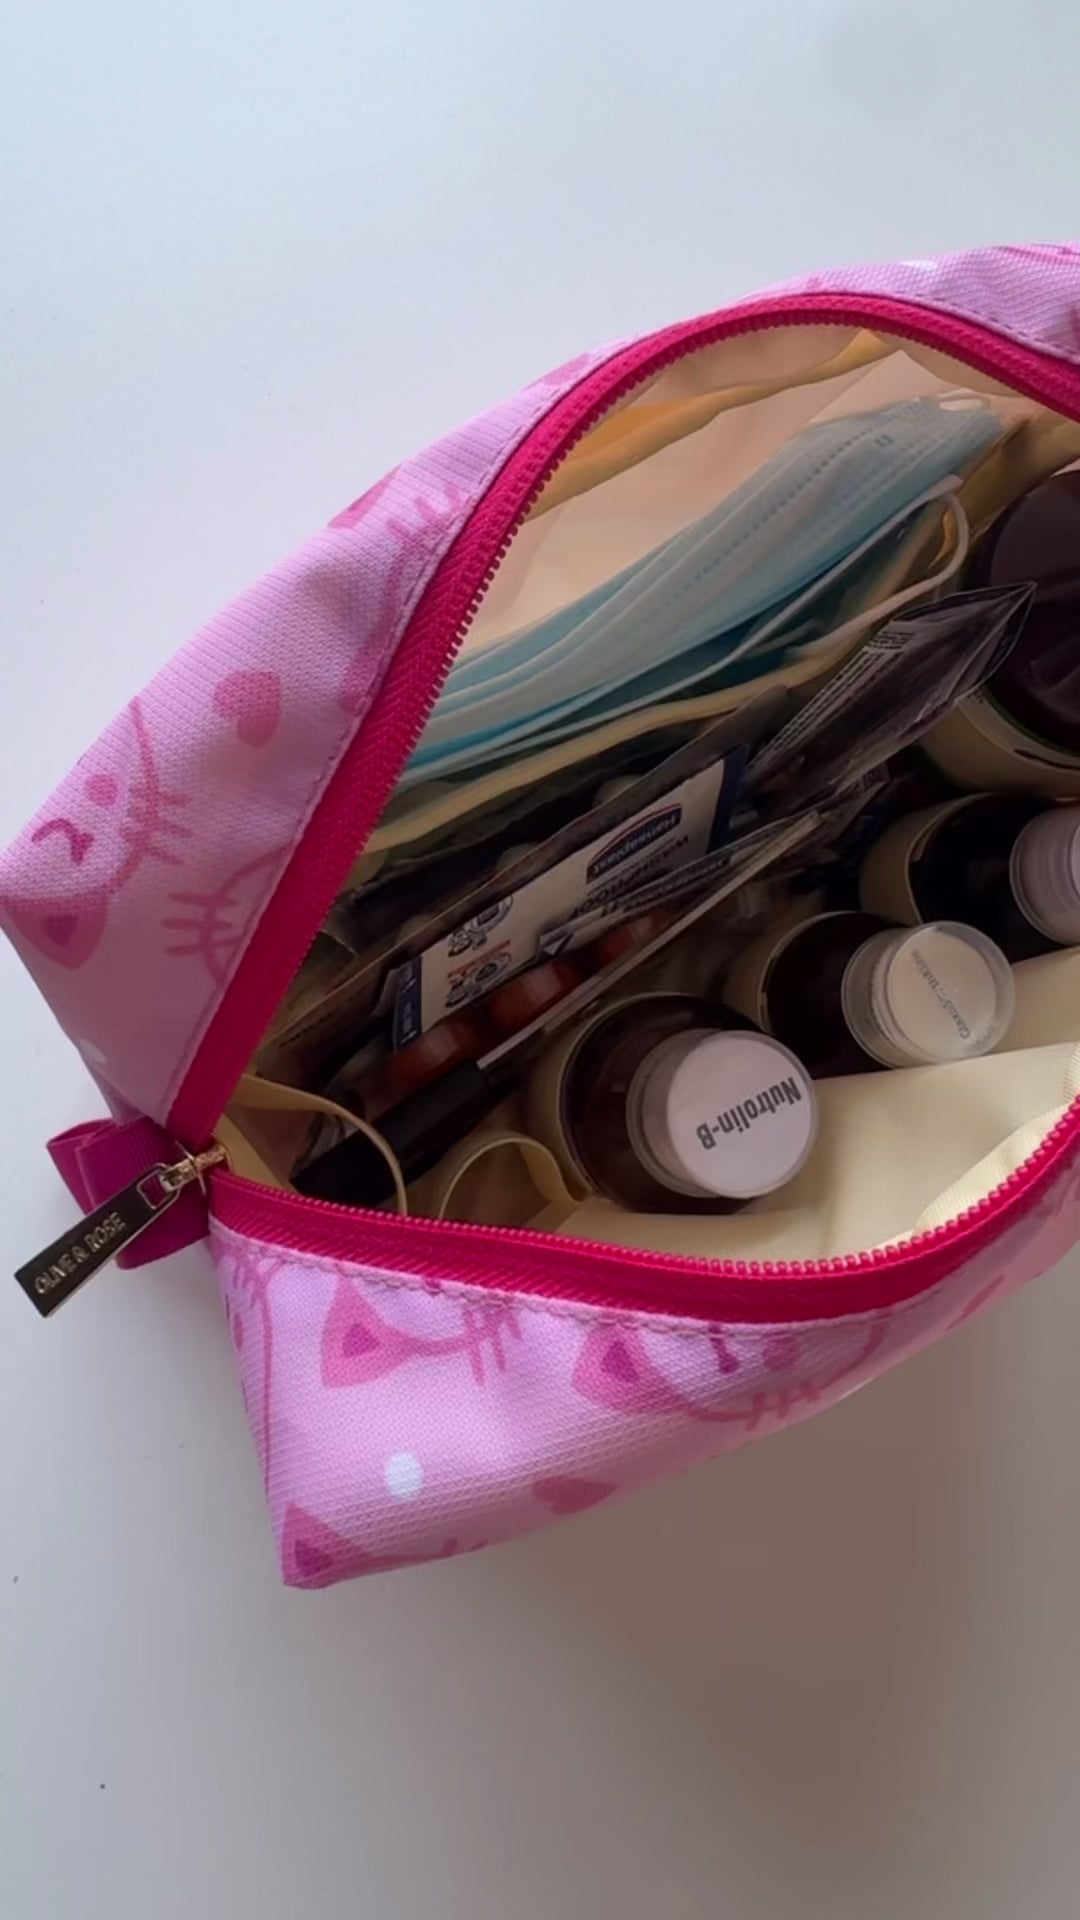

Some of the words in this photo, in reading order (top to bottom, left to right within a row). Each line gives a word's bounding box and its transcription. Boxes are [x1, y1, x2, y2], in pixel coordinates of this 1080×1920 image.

[696, 1077, 802, 1150] Nutrolin-B
[34, 1252, 77, 1294] OLIVE
[83, 1211, 126, 1253] ROSE
